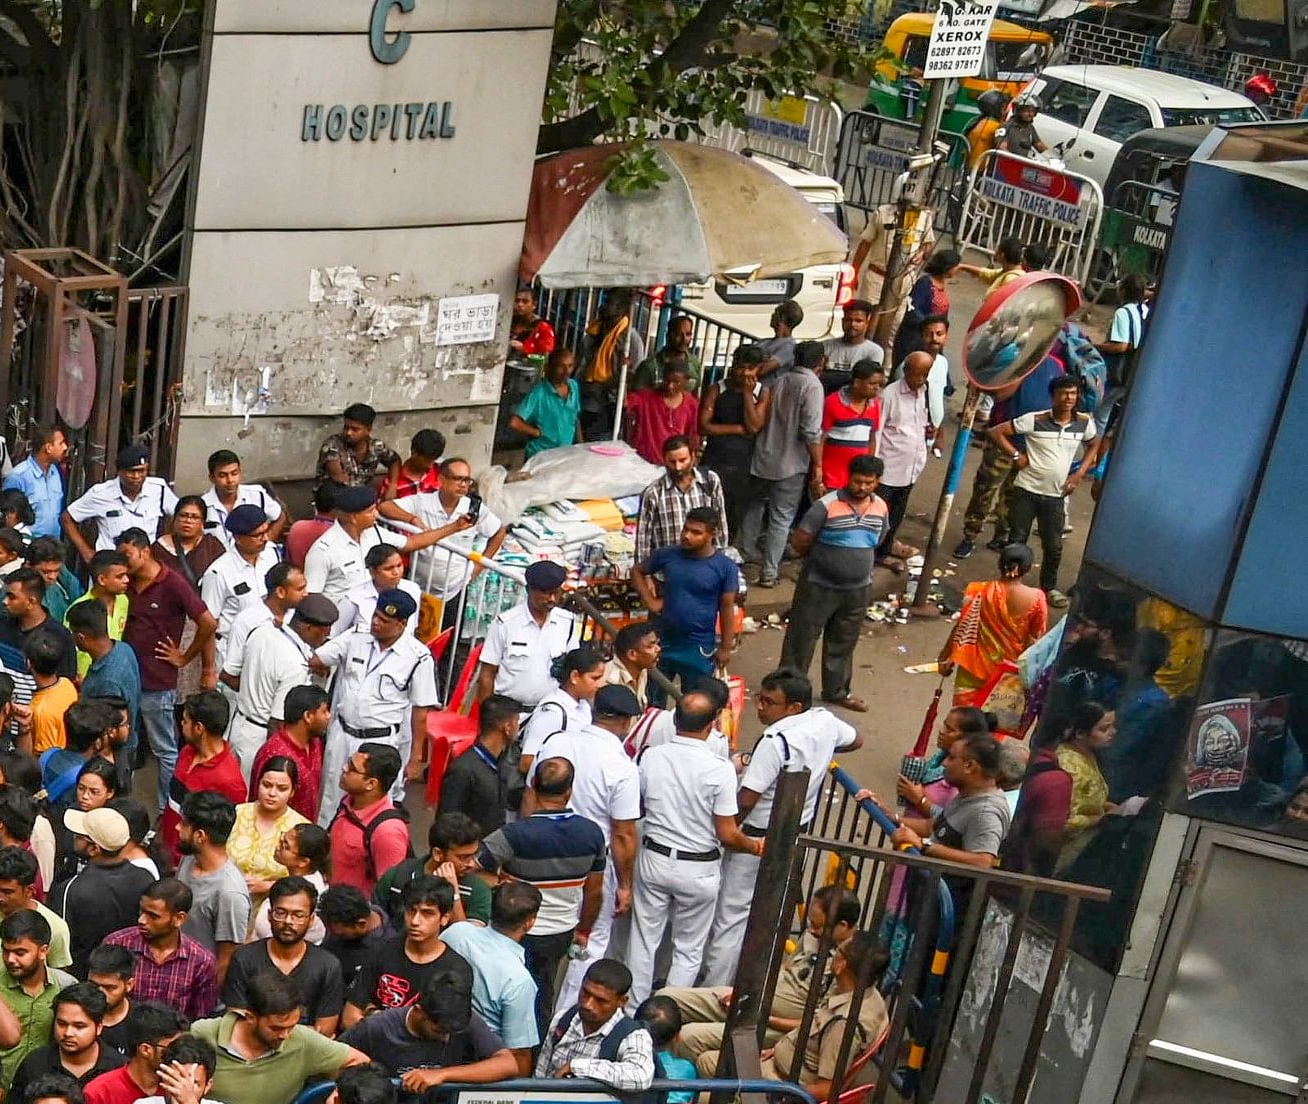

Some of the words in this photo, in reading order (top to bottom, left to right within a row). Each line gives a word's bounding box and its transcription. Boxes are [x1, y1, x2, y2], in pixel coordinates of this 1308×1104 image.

[369, 0, 416, 65] C
[936, 31, 983, 43] XEROX
[931, 46, 956, 57] 62897
[957, 46, 982, 56] 82673
[929, 61, 953, 70] 98362
[301, 102, 456, 142] HOSPITAL
[1018, 191, 1051, 218] TRAFFIC
[1052, 203, 1081, 226] POLICE
[1134, 226, 1167, 250] KOLKATA
